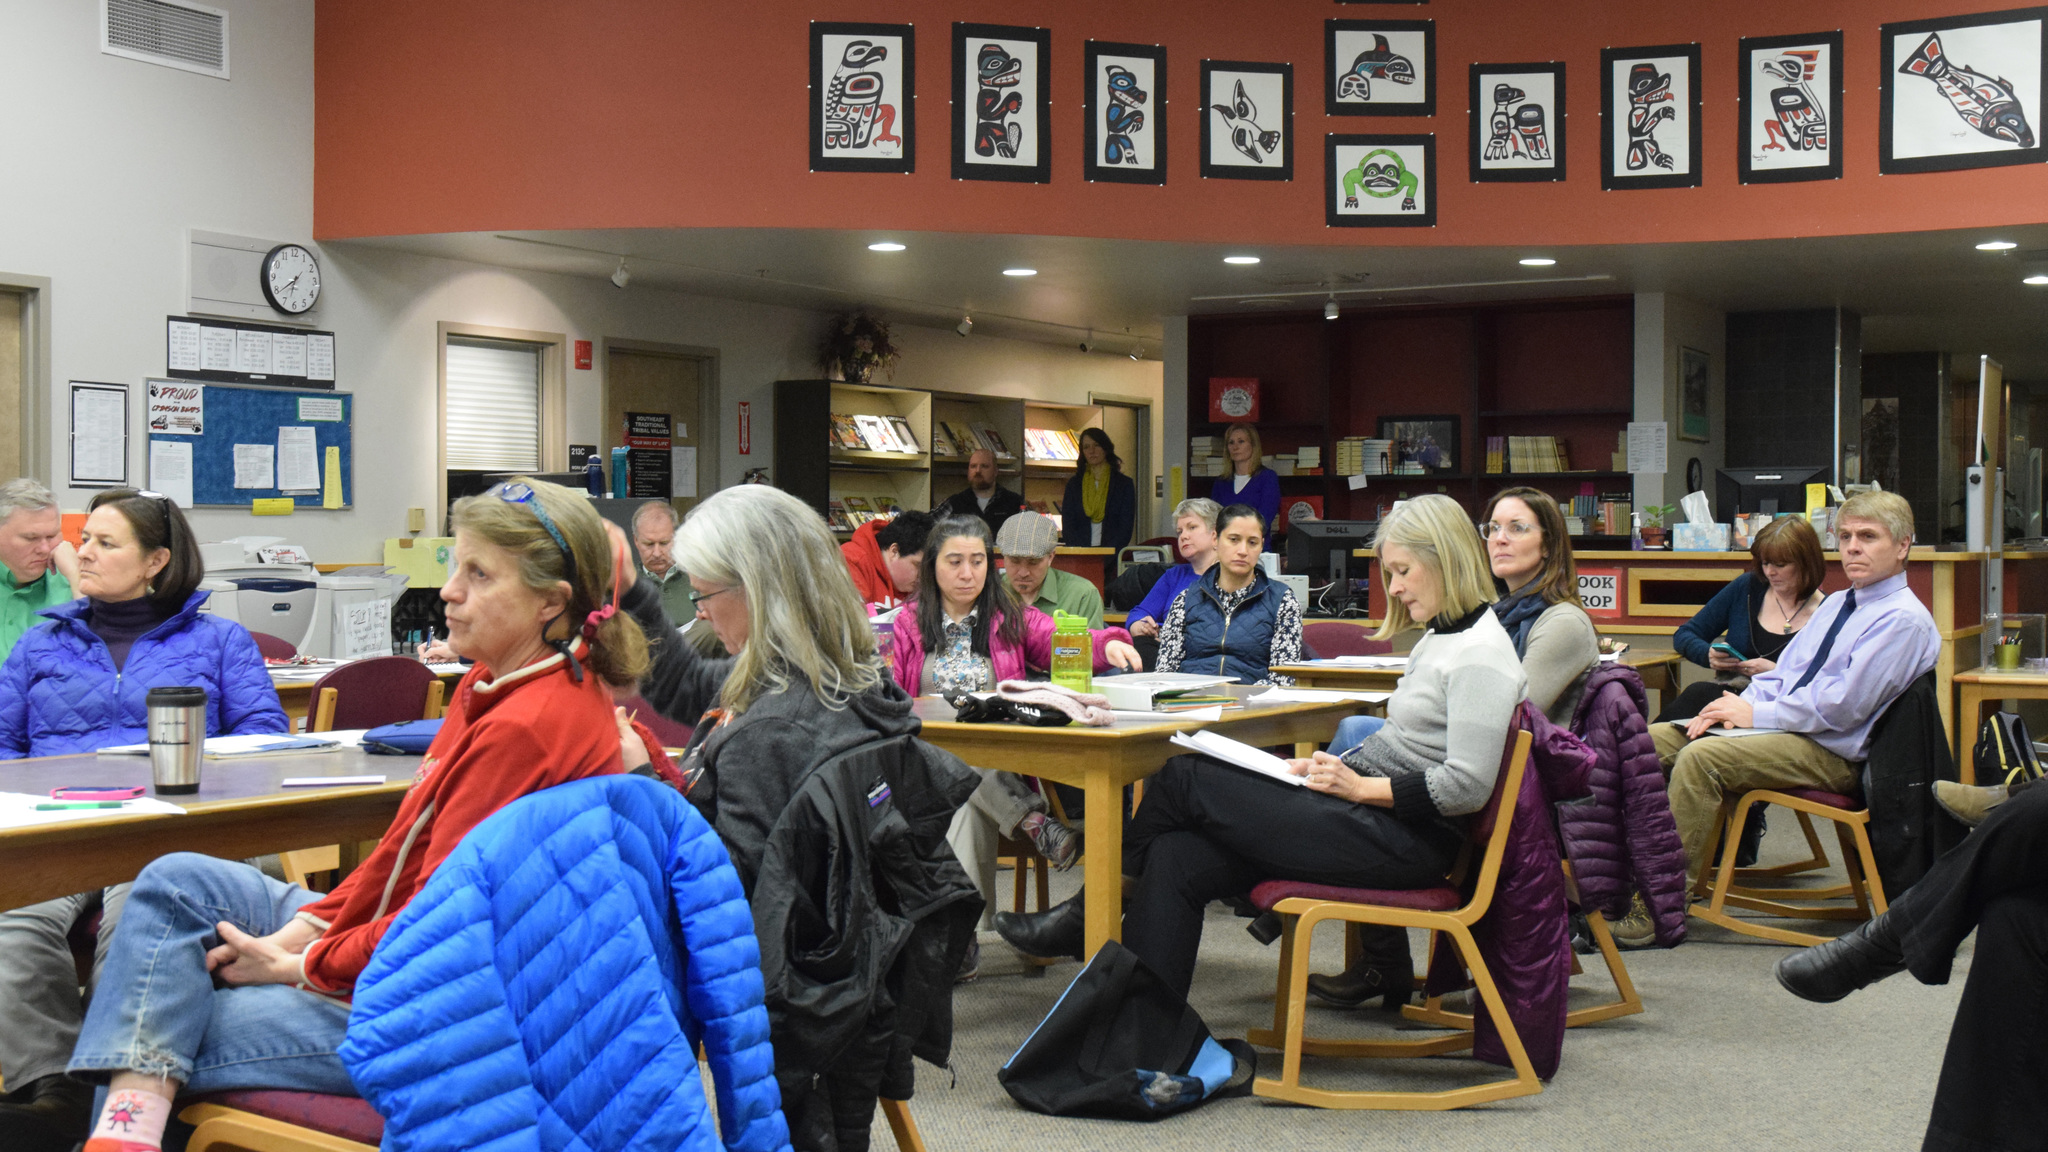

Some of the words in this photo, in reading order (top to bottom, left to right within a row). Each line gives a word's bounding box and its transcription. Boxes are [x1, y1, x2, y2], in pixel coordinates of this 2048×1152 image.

[282, 251, 288, 261] 11
[291, 248, 299, 258] 12
[302, 254, 306, 262] 1
[309, 264, 314, 273] 2
[271, 273, 276, 281] 9
[312, 277, 317, 286] 3
[274, 286, 279, 295] 8
[309, 290, 314, 298] 4
[282, 296, 287, 306] 7
[292, 301, 297, 310] 6
[302, 299, 307, 308] 5
[160, 387, 198, 400] PROUD
[571, 447, 585, 456] 213C
[1578, 576, 1614, 588] OOK
[1580, 595, 1612, 607] ROP
